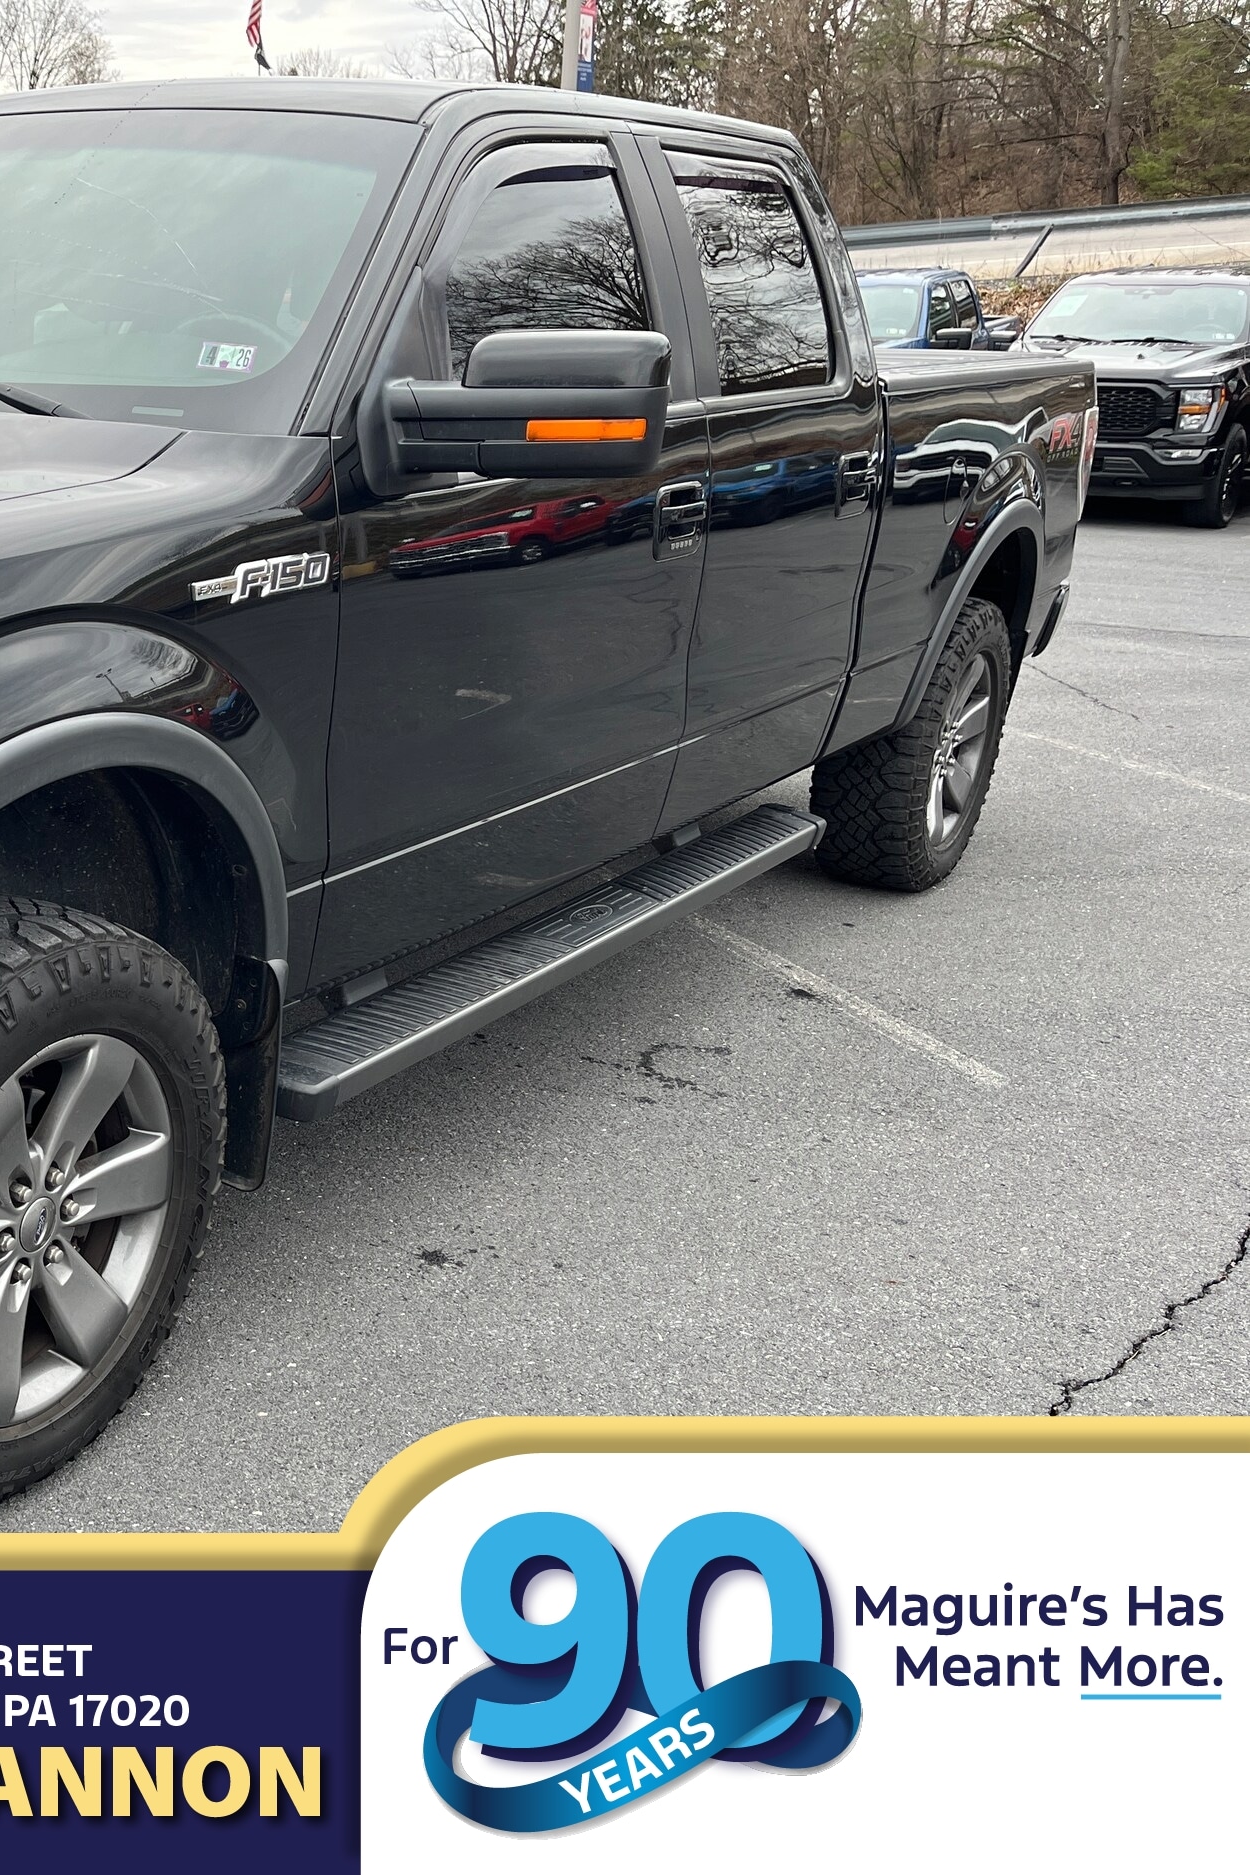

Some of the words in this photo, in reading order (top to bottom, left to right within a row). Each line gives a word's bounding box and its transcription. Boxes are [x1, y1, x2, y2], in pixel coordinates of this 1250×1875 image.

[235, 348, 252, 368] 26
[1049, 412, 1083, 453] FX4
[230, 553, 331, 604] F-150
